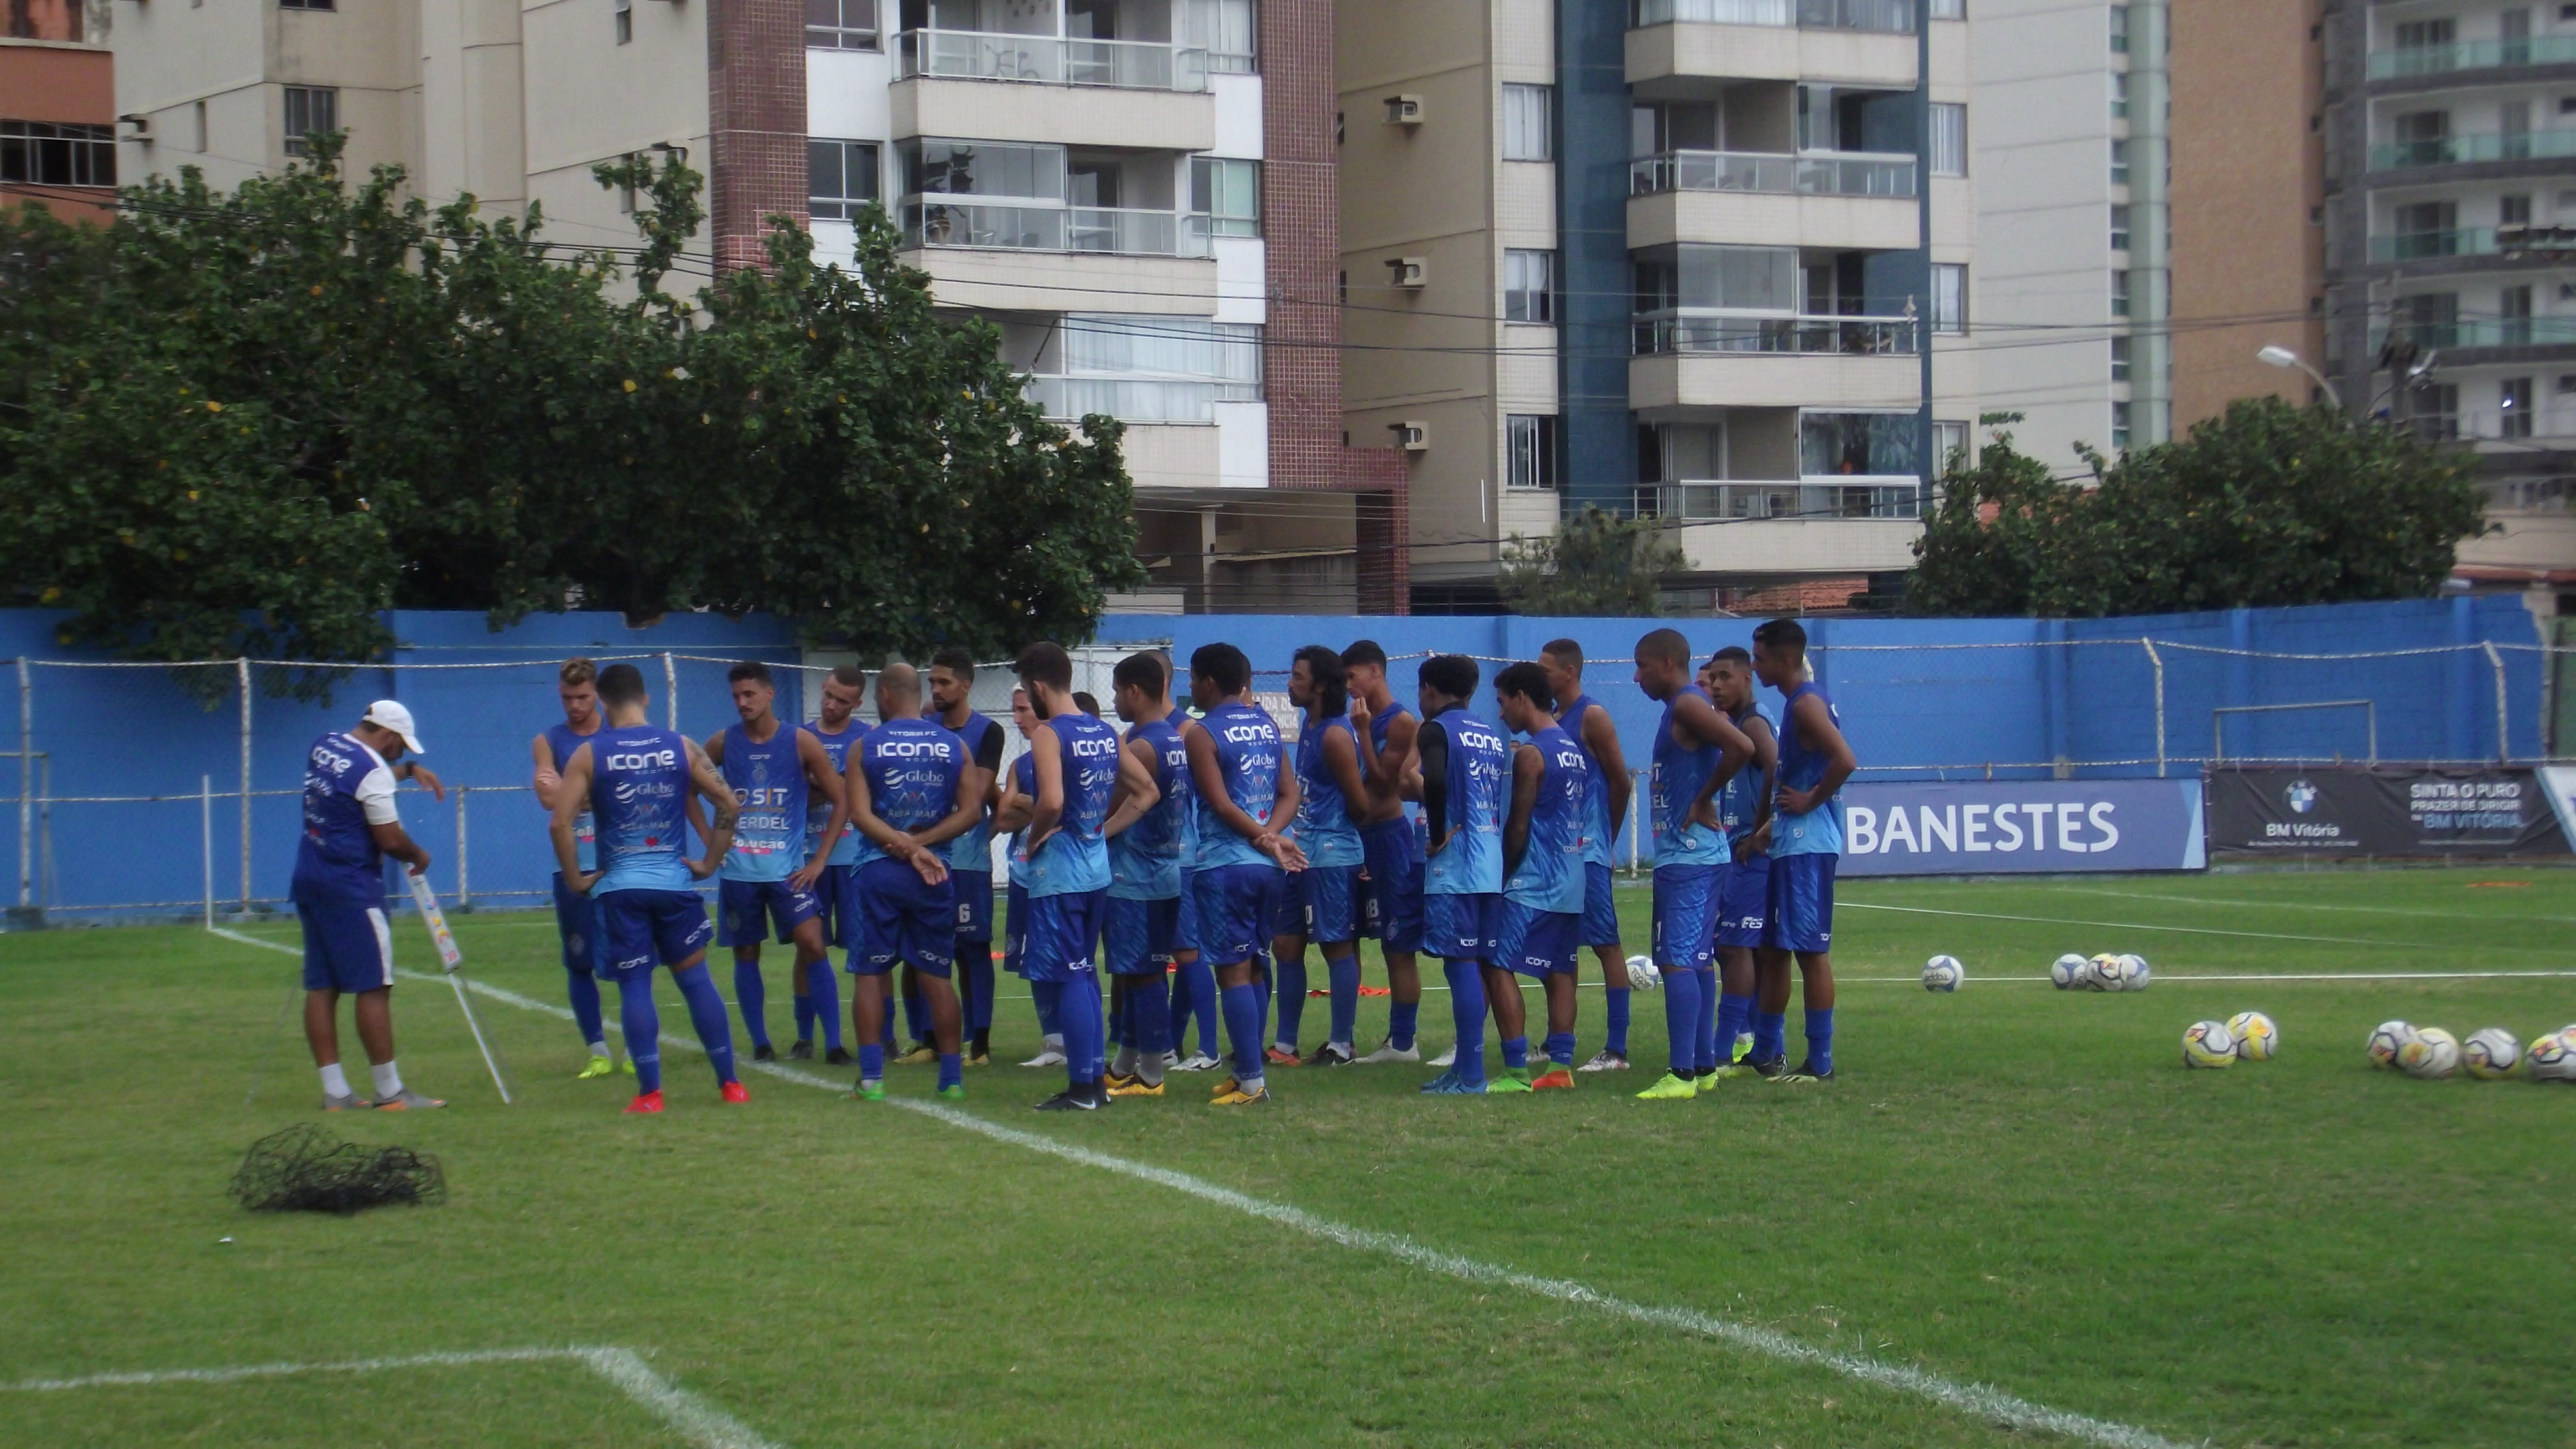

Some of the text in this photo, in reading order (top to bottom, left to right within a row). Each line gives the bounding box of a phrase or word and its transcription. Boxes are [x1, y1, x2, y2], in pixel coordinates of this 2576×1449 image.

[906, 770, 944, 782] Globo
[752, 788, 788, 805] SIT
[2460, 783, 2475, 797] O
[2476, 782, 2521, 797] PURO
[735, 817, 790, 830] ERDEL
[1846, 802, 2120, 854] BANESTES
[2266, 823, 2340, 837] BM Vitória
[958, 903, 970, 923] 6
